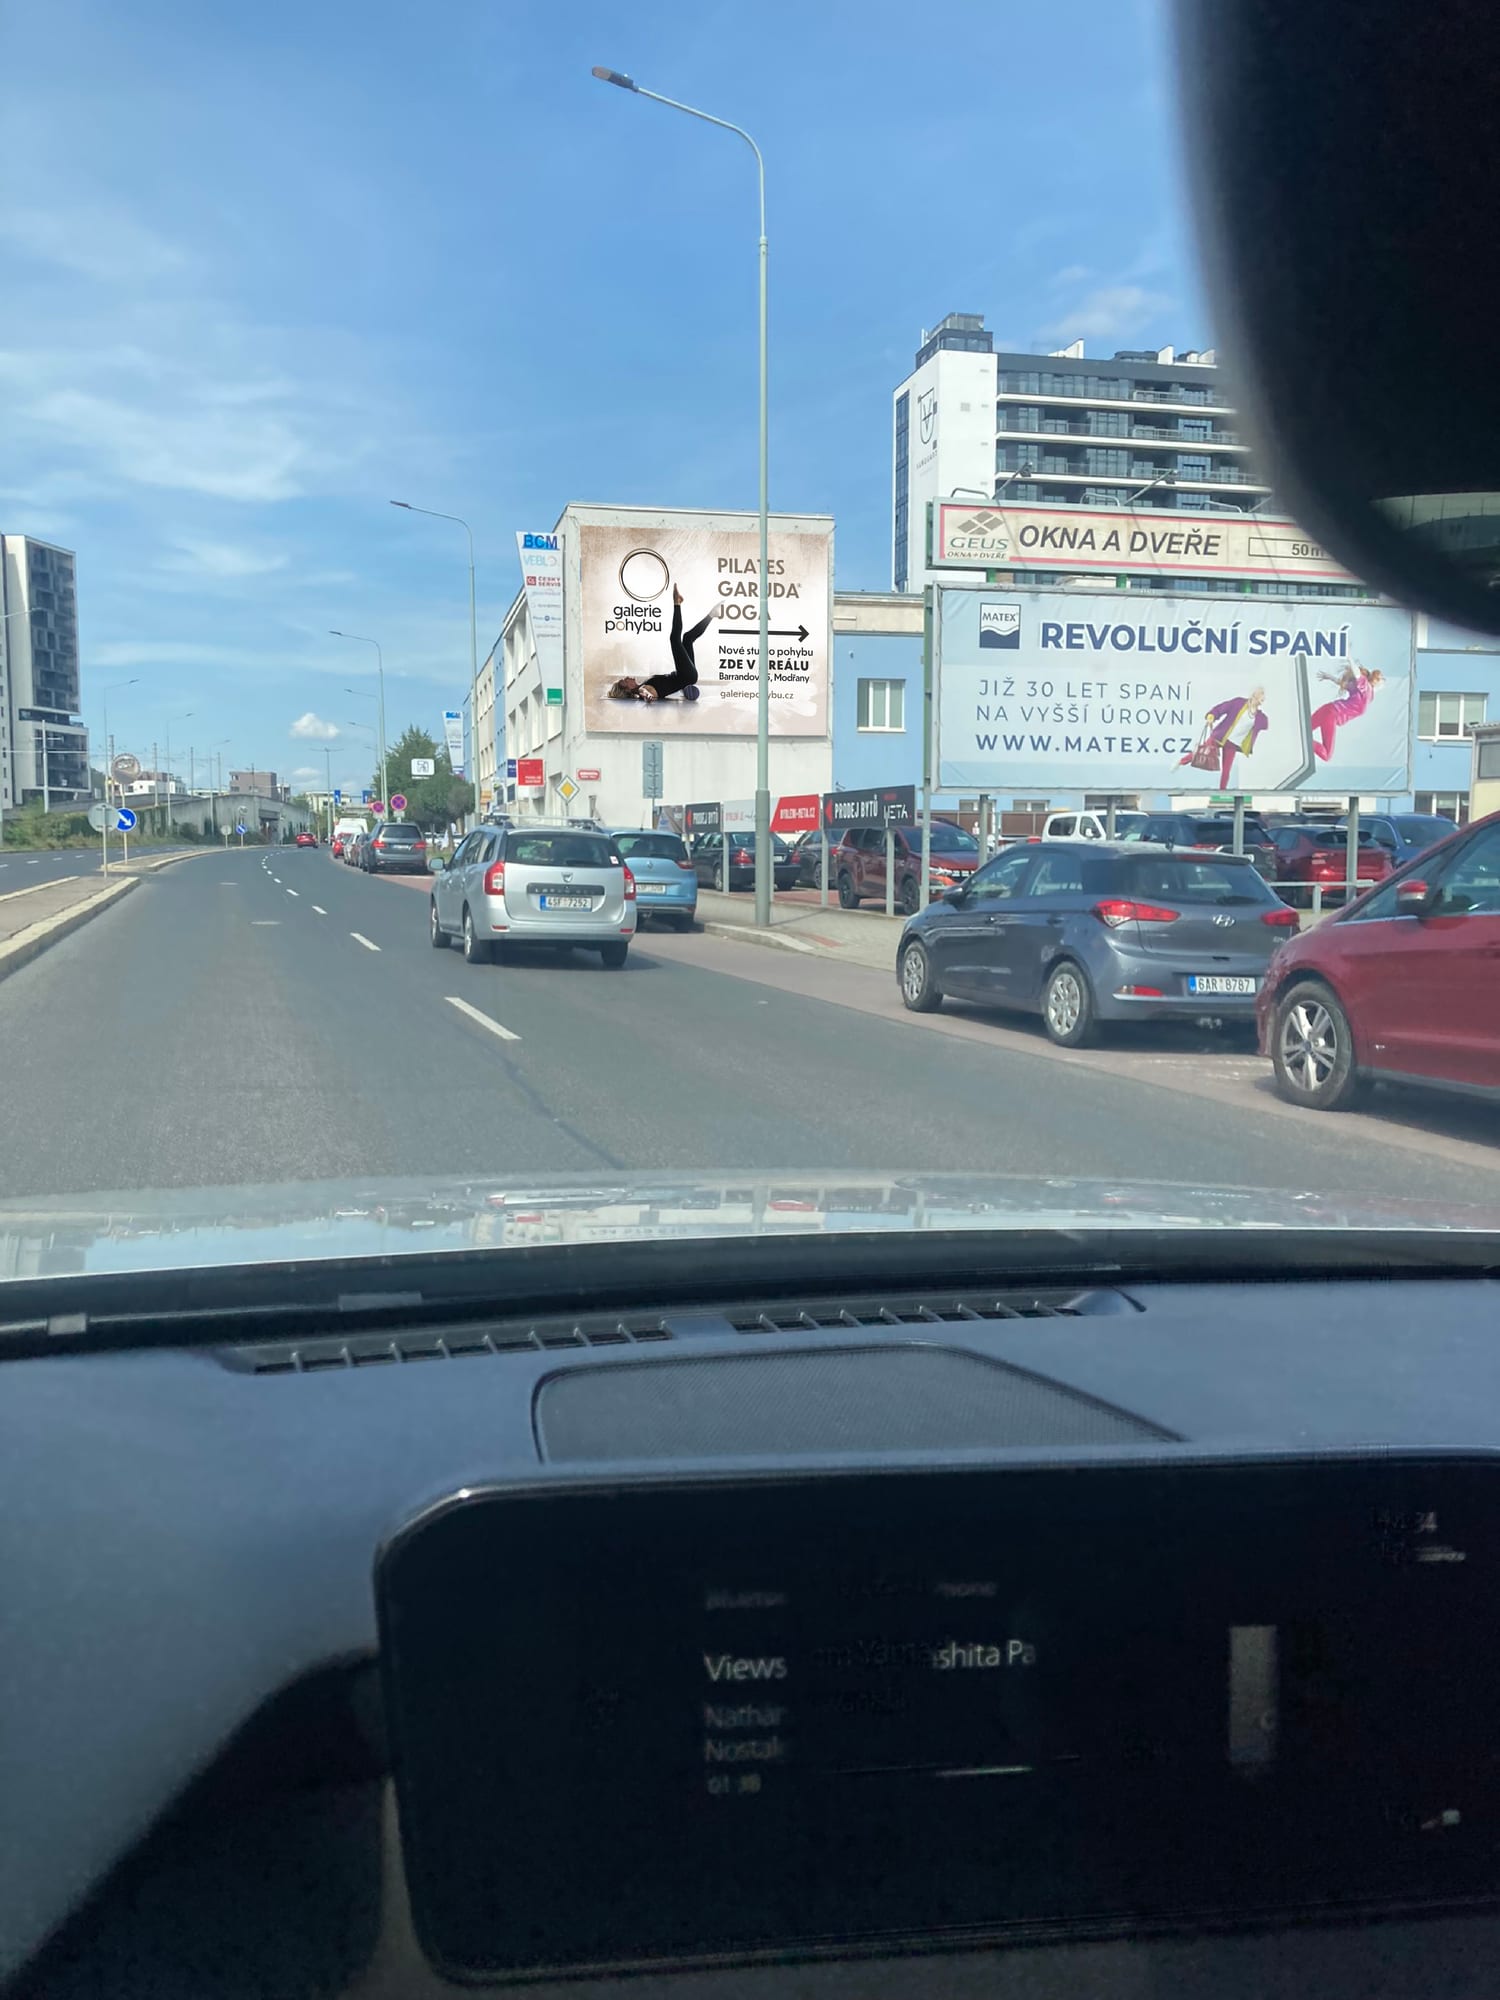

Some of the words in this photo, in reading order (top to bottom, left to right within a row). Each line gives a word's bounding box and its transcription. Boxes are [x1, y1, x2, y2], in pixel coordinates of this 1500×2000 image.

[950, 537, 1009, 550] GEUS
[1019, 525, 1096, 551] OKNA
[1102, 533, 1121, 552] A
[1130, 529, 1221, 556] DVEŘE
[613, 604, 662, 619] galerie
[982, 612, 1016, 622] MATEX
[605, 618, 662, 635] pohybu
[1041, 620, 1241, 655] REVOLUČNÍ
[1249, 624, 1349, 657] SPANÍ
[719, 645, 745, 655] Nové
[746, 647, 775, 656] stuo
[777, 647, 814, 658] pohybu
[719, 659, 743, 669] ZDE
[746, 659, 756, 670] V
[768, 658, 809, 671] REÁLU
[774, 673, 810, 684] Modřany
[720, 690, 794, 700] galeriepoybu.cz
[978, 677, 1015, 697] JIŽ
[1026, 681, 1054, 697] 30
[1066, 682, 1108, 698] LET
[1119, 681, 1192, 701] SPANÍ
[976, 705, 1008, 721] NA
[1020, 703, 1089, 724] VYŠŠÍ
[1101, 704, 1193, 725] ÚROVNI
[975, 734, 1193, 754] WWW.MATEX.CZ
[834, 799, 859, 819] PRODEJ
[859, 794, 878, 818] BYTŮ
[1198, 978, 1218, 991] 6AR
[704, 1654, 788, 1681] Views
